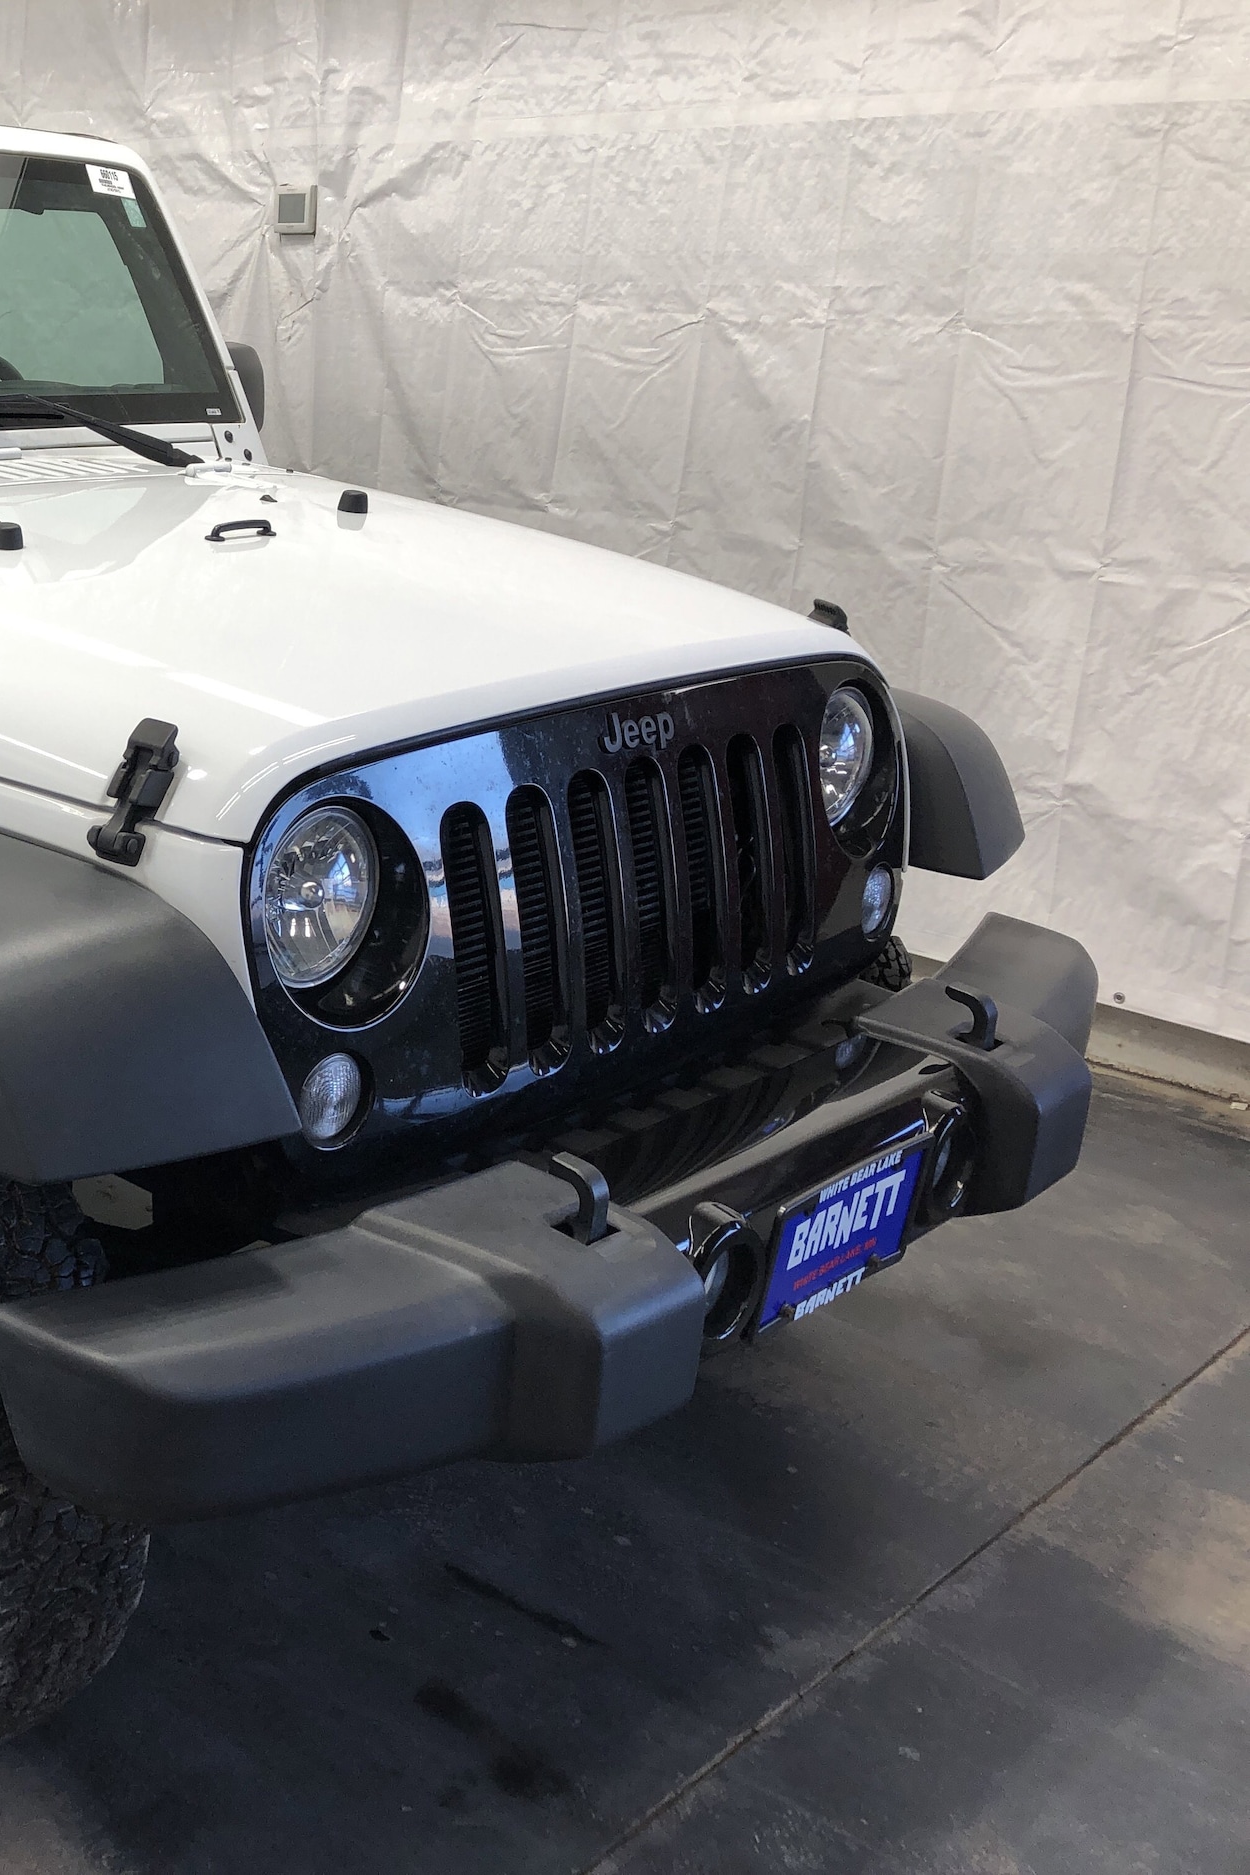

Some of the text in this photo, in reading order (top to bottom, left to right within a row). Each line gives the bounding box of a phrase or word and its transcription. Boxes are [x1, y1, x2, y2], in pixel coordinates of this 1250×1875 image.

[601, 710, 675, 753] Jeep
[819, 1149, 903, 1204] WHITE BEAR LAKE
[786, 1168, 907, 1271] BARNETT
[793, 1266, 867, 1321] BARNETT
